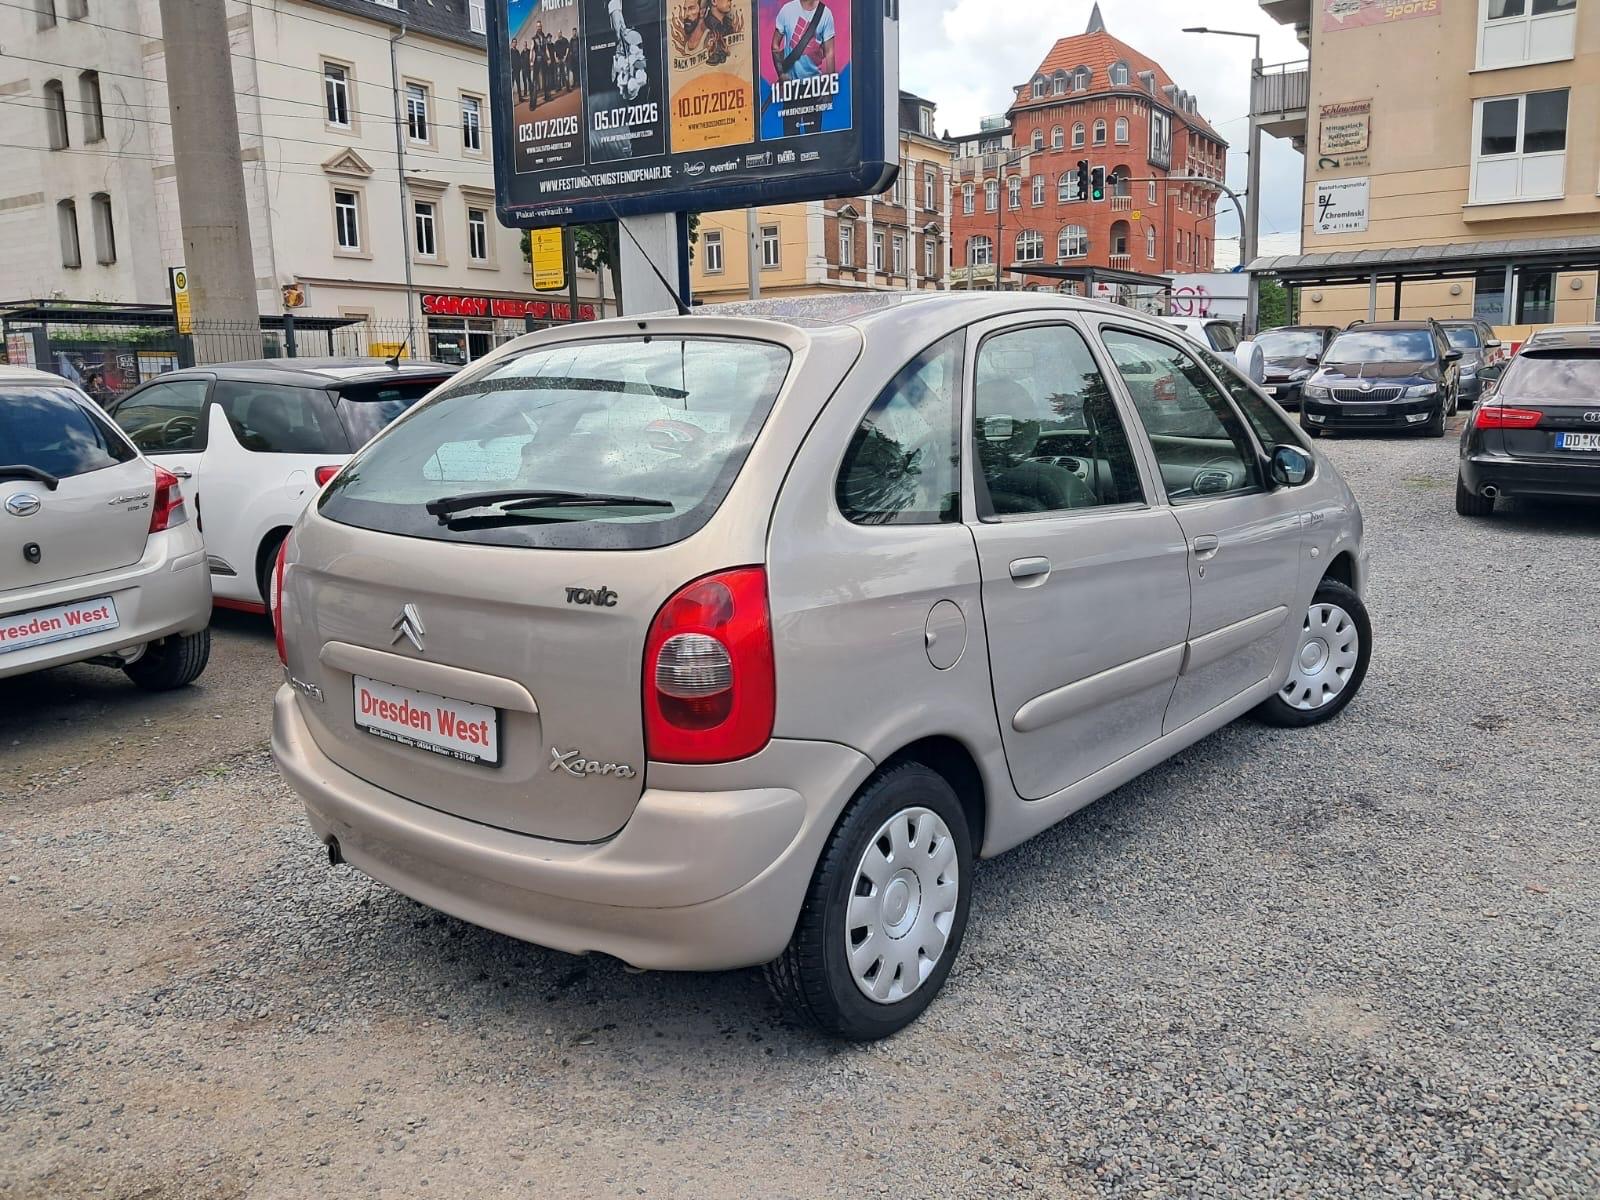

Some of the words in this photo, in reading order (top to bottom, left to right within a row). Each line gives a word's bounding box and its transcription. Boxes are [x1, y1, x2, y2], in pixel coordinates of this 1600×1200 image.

[1384, 0, 1437, 19] sports
[673, 57, 689, 69] BACK
[689, 57, 698, 67] TO
[697, 52, 708, 64] THE
[771, 73, 839, 103] 11.07.2026
[678, 88, 745, 118] 10.07.2026
[594, 102, 658, 131] 05.07.2026
[519, 115, 578, 142] 03.07.2026
[709, 160, 738, 173] eventim
[539, 165, 672, 193] WWW.FESTUNGKOENIGSTEINOPENAIR.DE
[515, 206, 573, 220] Plakat-verkauft.de
[1325, 209, 1365, 219] Chrominski
[422, 294, 488, 316] SARAY
[1565, 434, 1580, 446] DD
[1590, 435, 1600, 447] K
[64, 606, 110, 626] West
[360, 688, 432, 732] Dresden
[436, 708, 489, 747] West
[548, 746, 636, 779] Xsara
